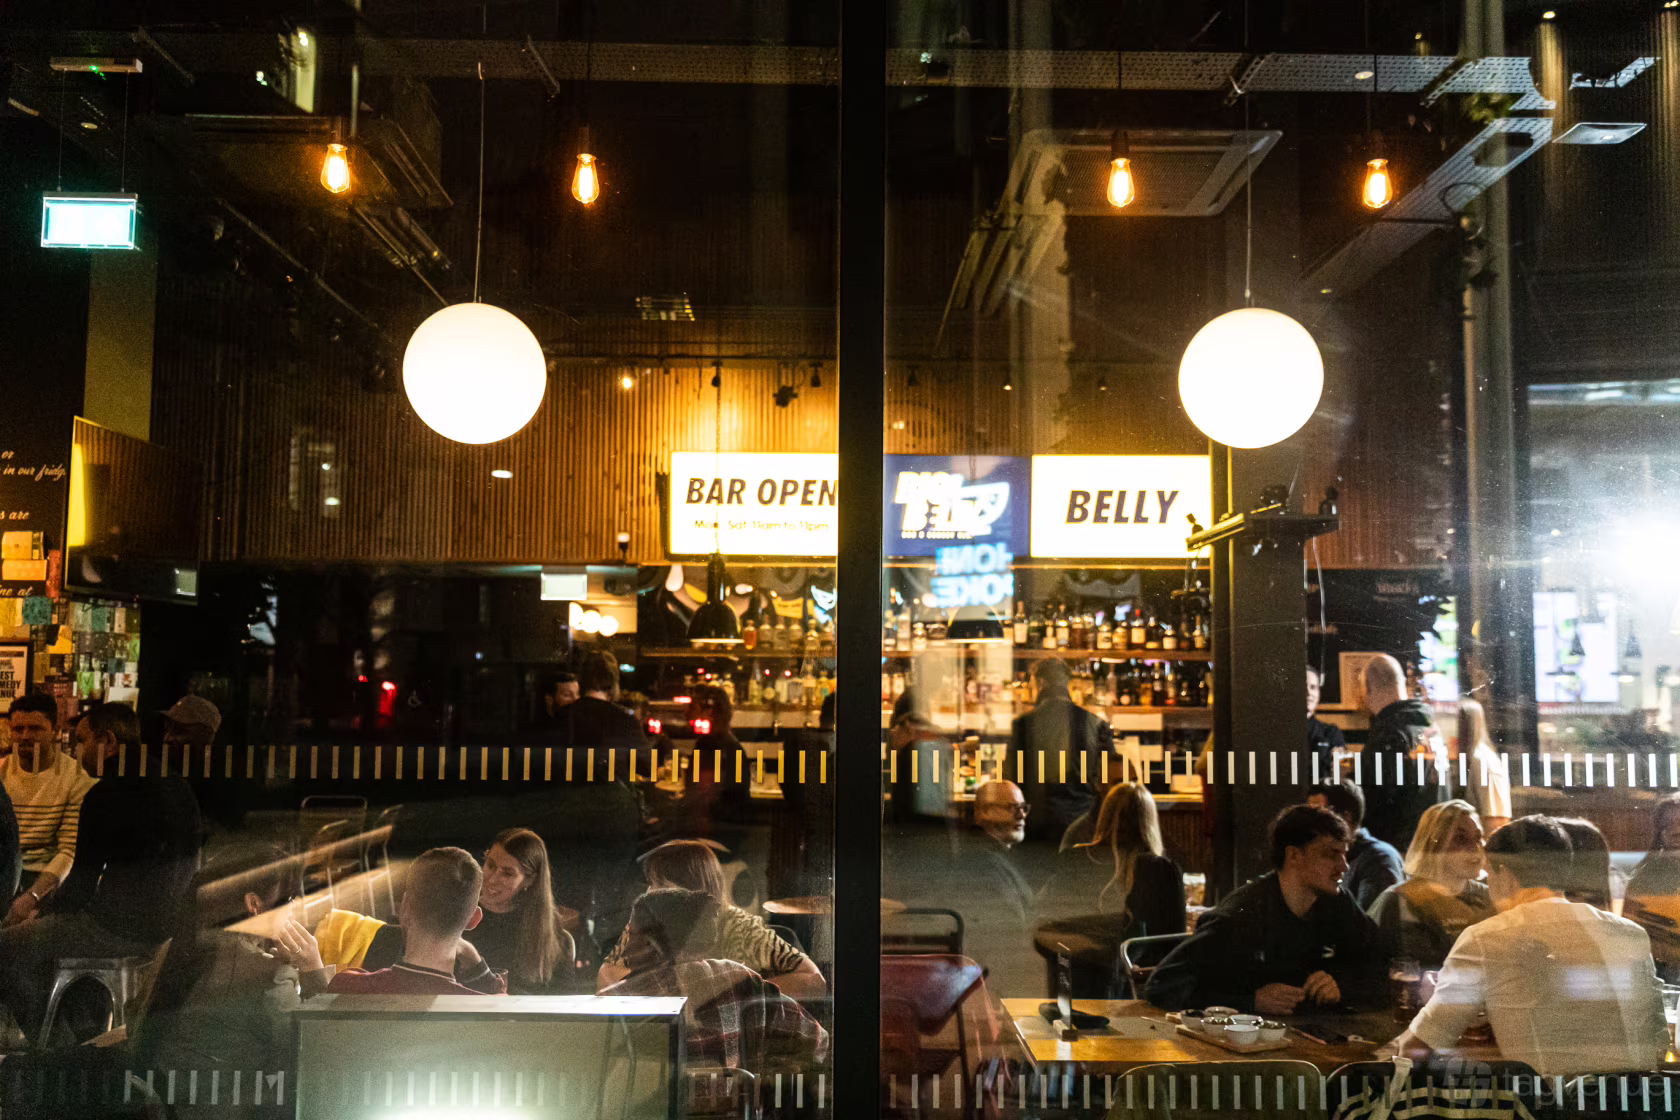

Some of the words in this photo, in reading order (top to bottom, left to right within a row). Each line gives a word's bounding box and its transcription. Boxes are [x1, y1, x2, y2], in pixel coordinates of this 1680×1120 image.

[686, 478, 746, 504] BAR
[757, 478, 838, 506] OPEN
[1066, 490, 1179, 523] BELLY
[728, 520, 747, 530] Sat
[784, 521, 796, 530] to
